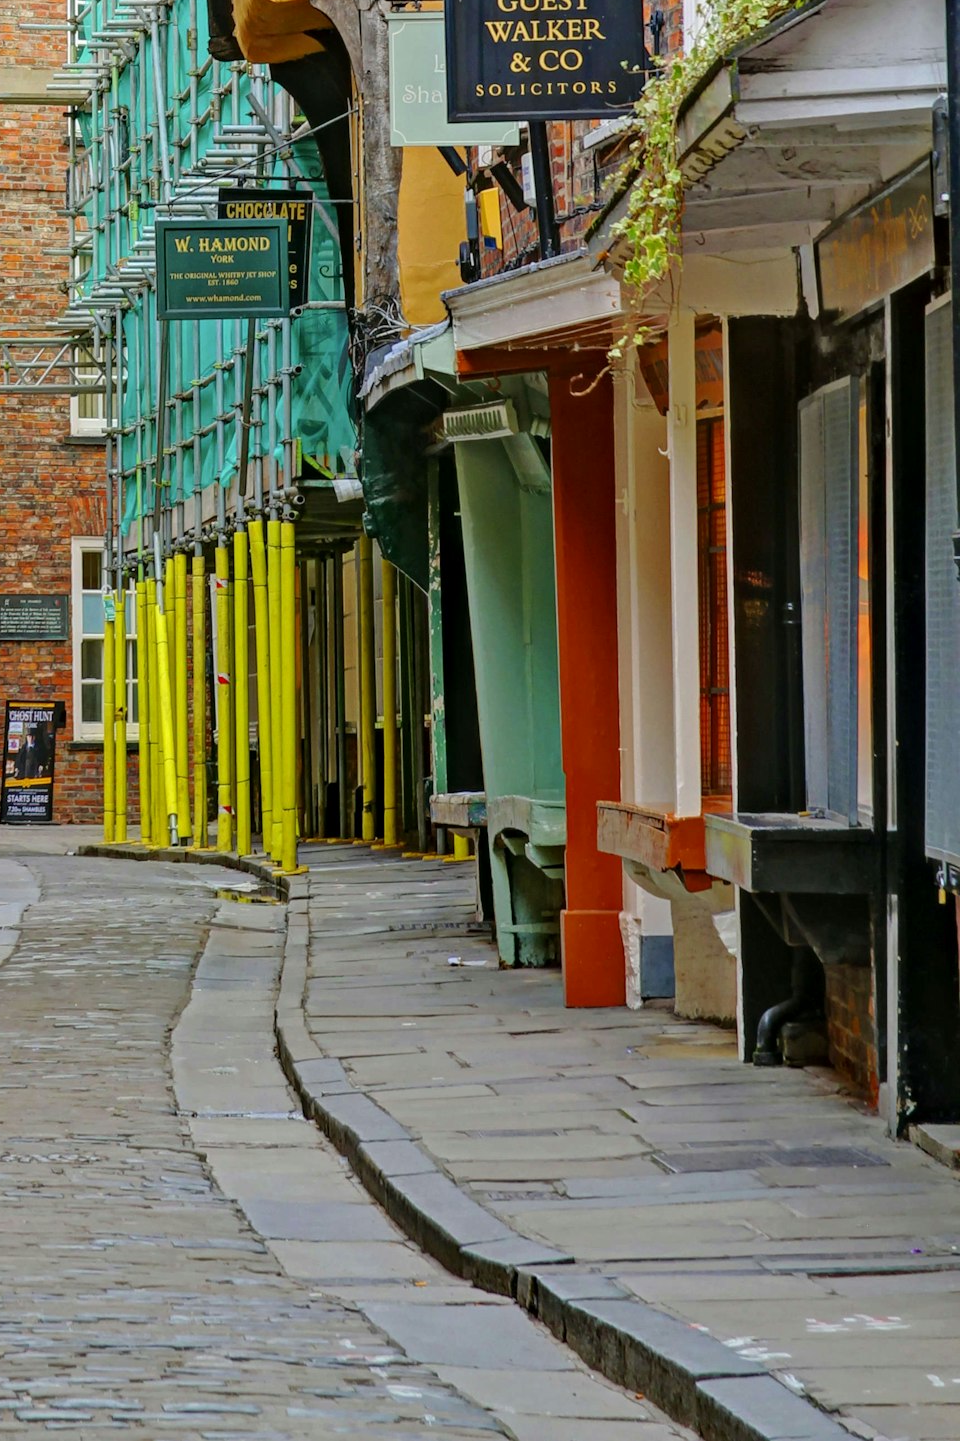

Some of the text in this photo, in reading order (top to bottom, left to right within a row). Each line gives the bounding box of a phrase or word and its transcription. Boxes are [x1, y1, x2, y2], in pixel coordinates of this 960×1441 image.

[485, 18, 606, 43] WALKER
[510, 49, 583, 72] & CO
[475, 80, 618, 97] SOLICITORS
[226, 202, 305, 220] CHOCOLATE
[175, 236, 271, 253] W. HAMOND
[211, 254, 234, 263] YORK
[218, 271, 246, 279] WHITBY
[246, 271, 257, 279] JET
[186, 294, 262, 302] www.whamond.com
[9, 710, 54, 721] GHOST HUNT
[7, 795, 49, 803] STARTS HERE
